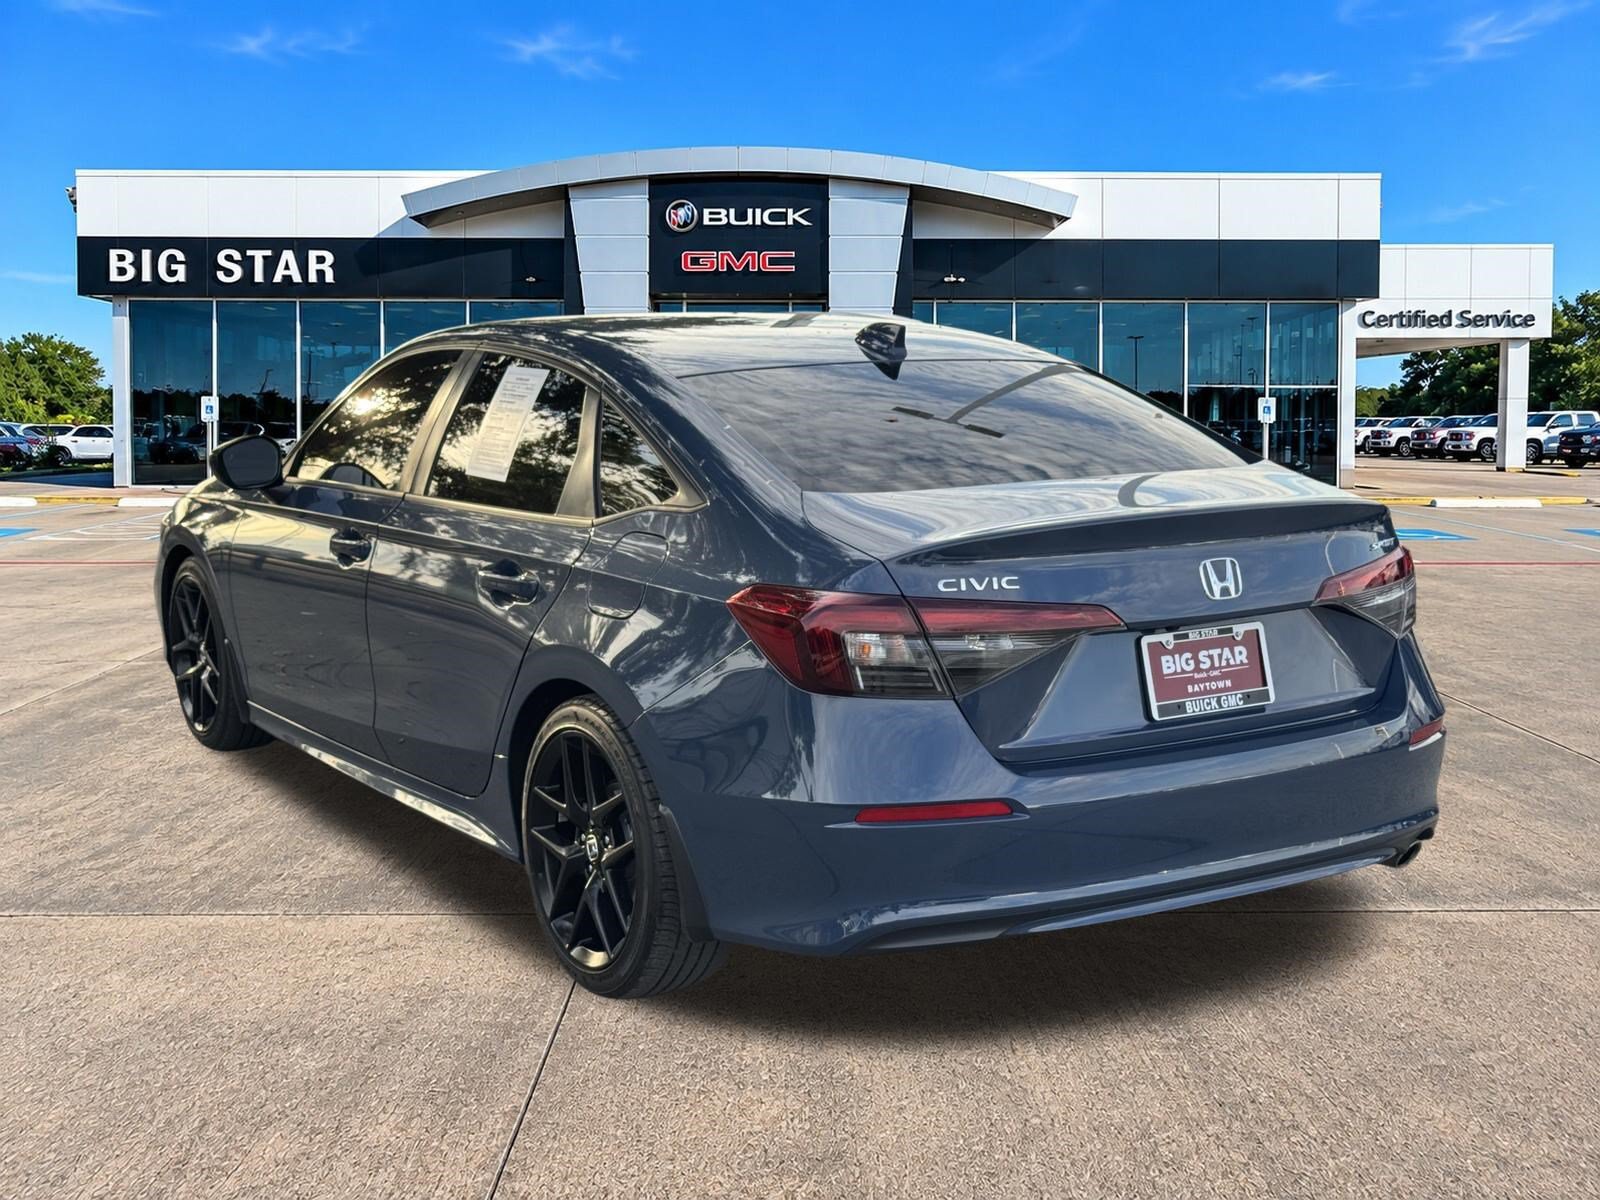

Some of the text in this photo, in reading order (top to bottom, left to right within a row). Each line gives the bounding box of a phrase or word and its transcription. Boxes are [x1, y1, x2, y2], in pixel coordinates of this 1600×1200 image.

[702, 207, 813, 227] BUICK
[108, 248, 336, 284] BIG STAR
[681, 251, 796, 272] GMC
[1358, 309, 1536, 329] Certified Service
[937, 576, 1020, 592] CIVIC
[1189, 629, 1217, 639] BIG STAR
[1160, 646, 1248, 674] BIG STAR
[1187, 680, 1231, 693] BAYTOWN
[1185, 694, 1244, 713] BUICK GMC
